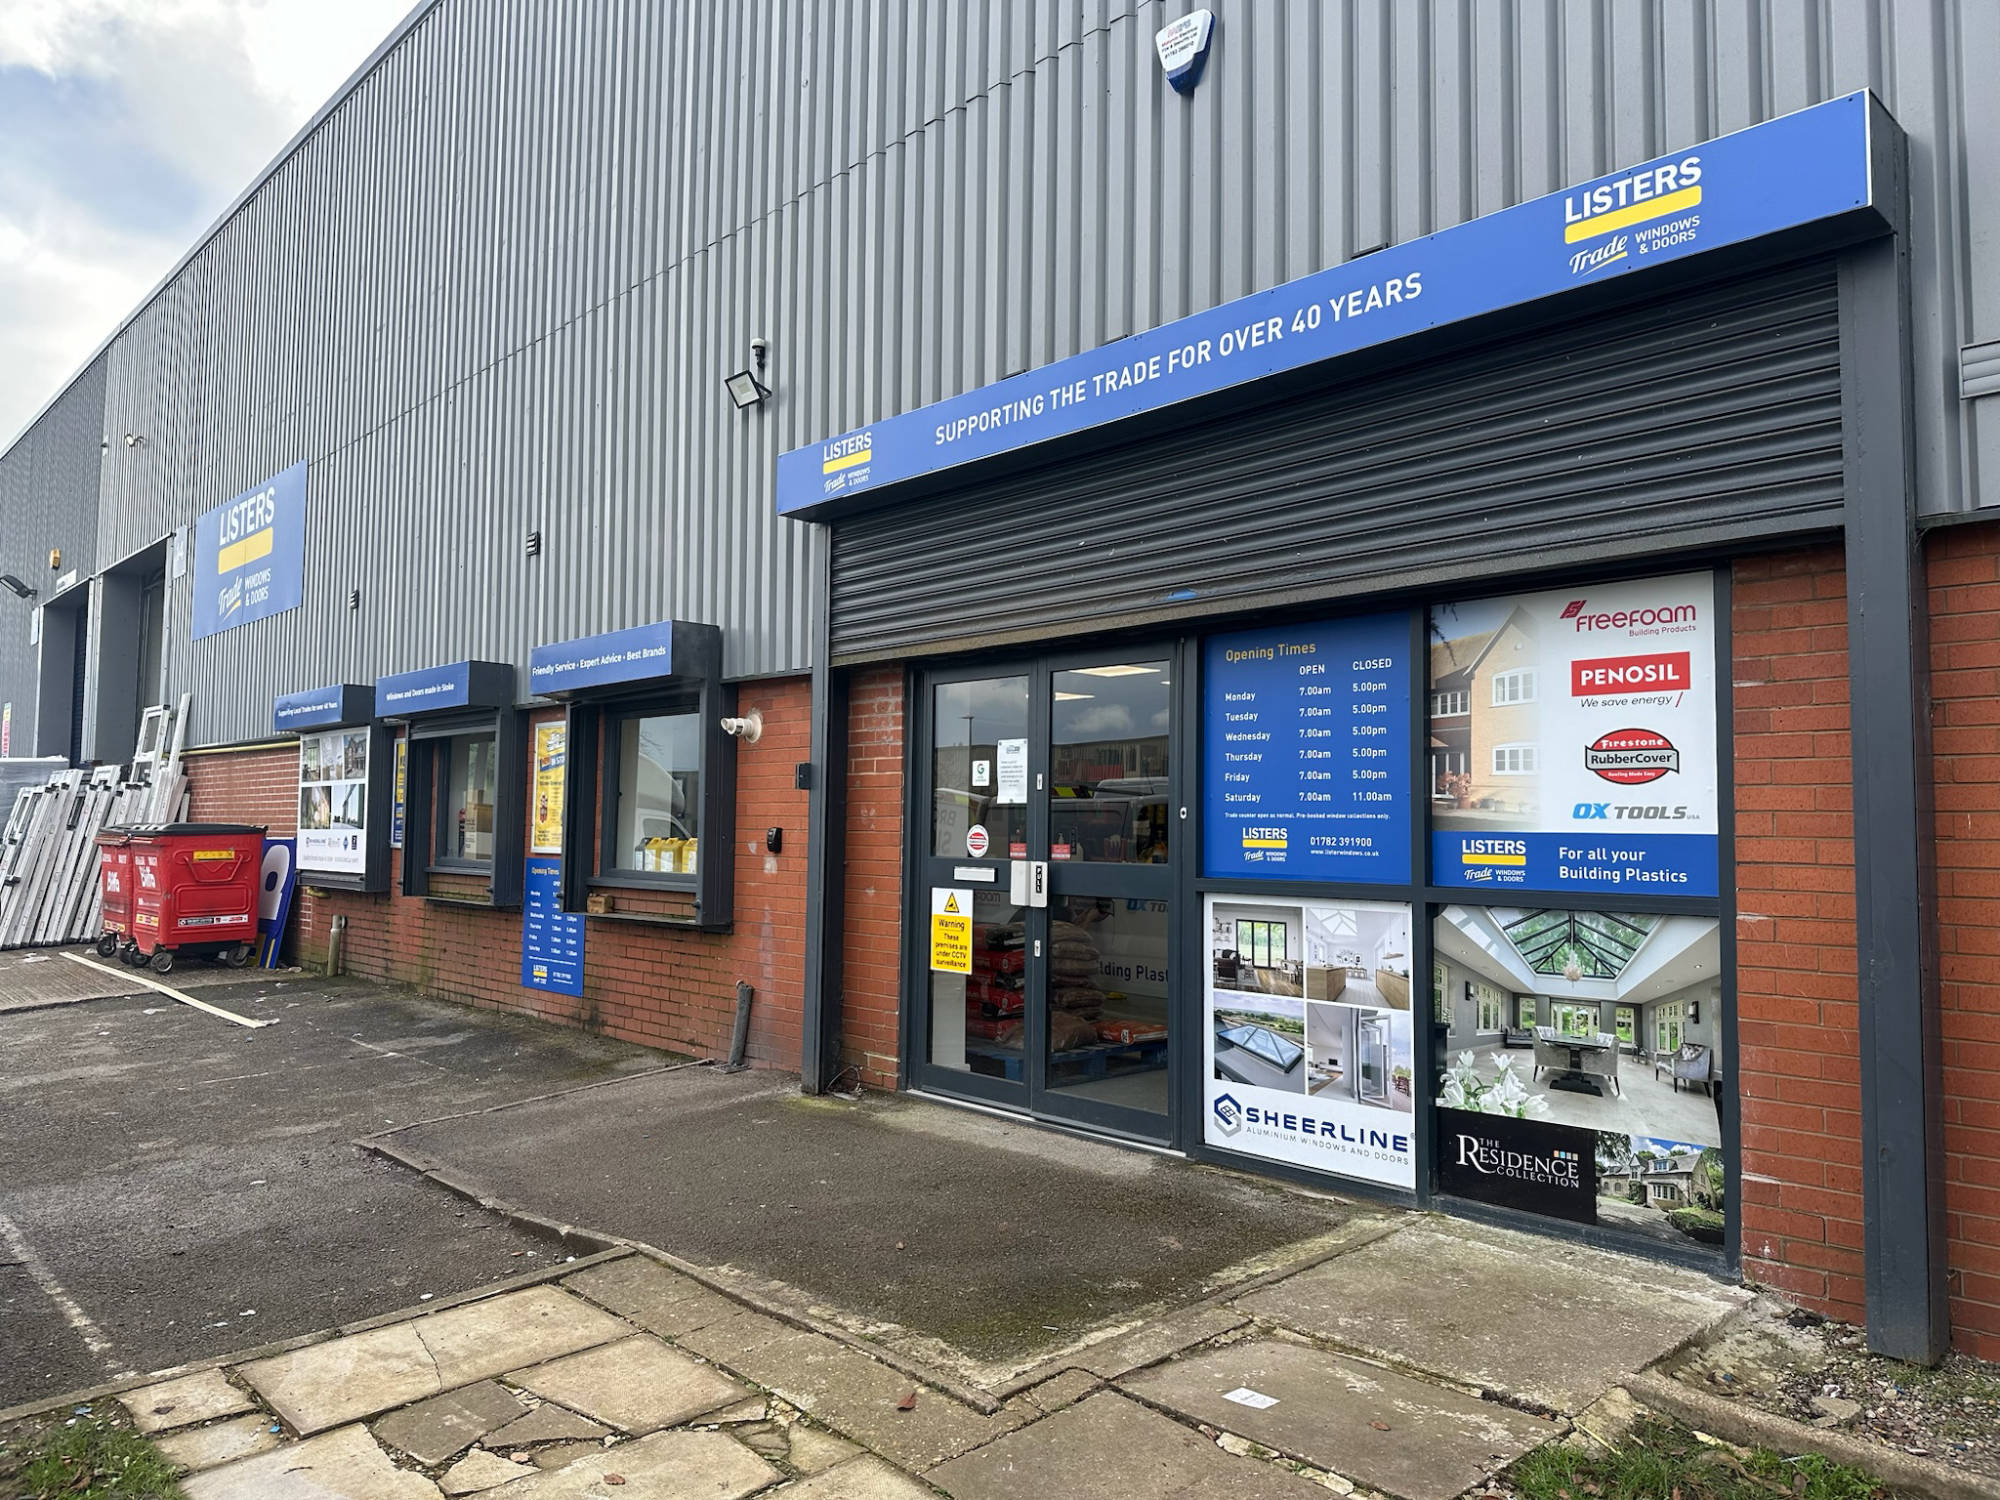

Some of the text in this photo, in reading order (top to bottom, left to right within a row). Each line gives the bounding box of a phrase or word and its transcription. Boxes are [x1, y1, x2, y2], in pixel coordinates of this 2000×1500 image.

[1565, 156, 1701, 223] LISTERS
[1635, 216, 1700, 243] WINDOWS
[1639, 229, 1696, 254] & DOORS
[1569, 235, 1628, 274] Trade
[936, 272, 1422, 445] SUPPORTING THE TRADE FOR OVER 40 YEARS
[823, 432, 872, 461] LISTERS
[824, 472, 846, 493] Trade
[219, 486, 275, 546] LISTERS
[244, 568, 271, 590] WINDOWS
[218, 575, 242, 616] Trade
[245, 586, 269, 607] & DOORS
[1629, 625, 1697, 637] Building Products
[1225, 642, 1316, 663] Opening Times
[532, 646, 666, 677] Friendly Service Expert Advice Best Brands
[1299, 658, 1392, 676] OPEN CLOSED
[1580, 663, 1680, 686] PENOSIL
[1225, 682, 1387, 702] Monday 7.00am 5.00pm
[1580, 695, 1673, 708] We save energy
[1225, 704, 1387, 723] Tuesday 7.00am 5.00pm
[1225, 726, 1387, 742] Wednesday 7.00am 5.00pm
[1601, 738, 1665, 749] Firestone
[1225, 748, 1387, 763] Thursday 7.00am 5.00pm
[1225, 770, 1387, 783] Friday 7.00am 5.00pm
[1225, 791, 1392, 804] Saturday 7.00am 11.00am
[1572, 803, 1611, 819] OX
[1614, 806, 1687, 819] TOOLS
[1242, 827, 1288, 839] LISTERS
[1310, 836, 1372, 847] 01782 391900
[1243, 850, 1264, 861] Trade
[1462, 839, 1526, 855] LISTERS
[1559, 847, 1646, 864] For all your
[1464, 867, 1493, 881] Trade
[1559, 866, 1688, 883] Building Plastics
[1150, 902, 1168, 912] TO
[938, 919, 965, 932] Warning
[944, 933, 959, 941] These
[935, 942, 958, 950] premises
[936, 950, 966, 959] under CCTV
[1100, 962, 1131, 981] lding
[1246, 1107, 1408, 1152] SHEERLINE
[1246, 1126, 1409, 1166] ALUMINIUM WINDOWS AND DOORS
[1479, 1137, 1500, 1148] THE
[1496, 1166, 1579, 1188] COLLECTION
